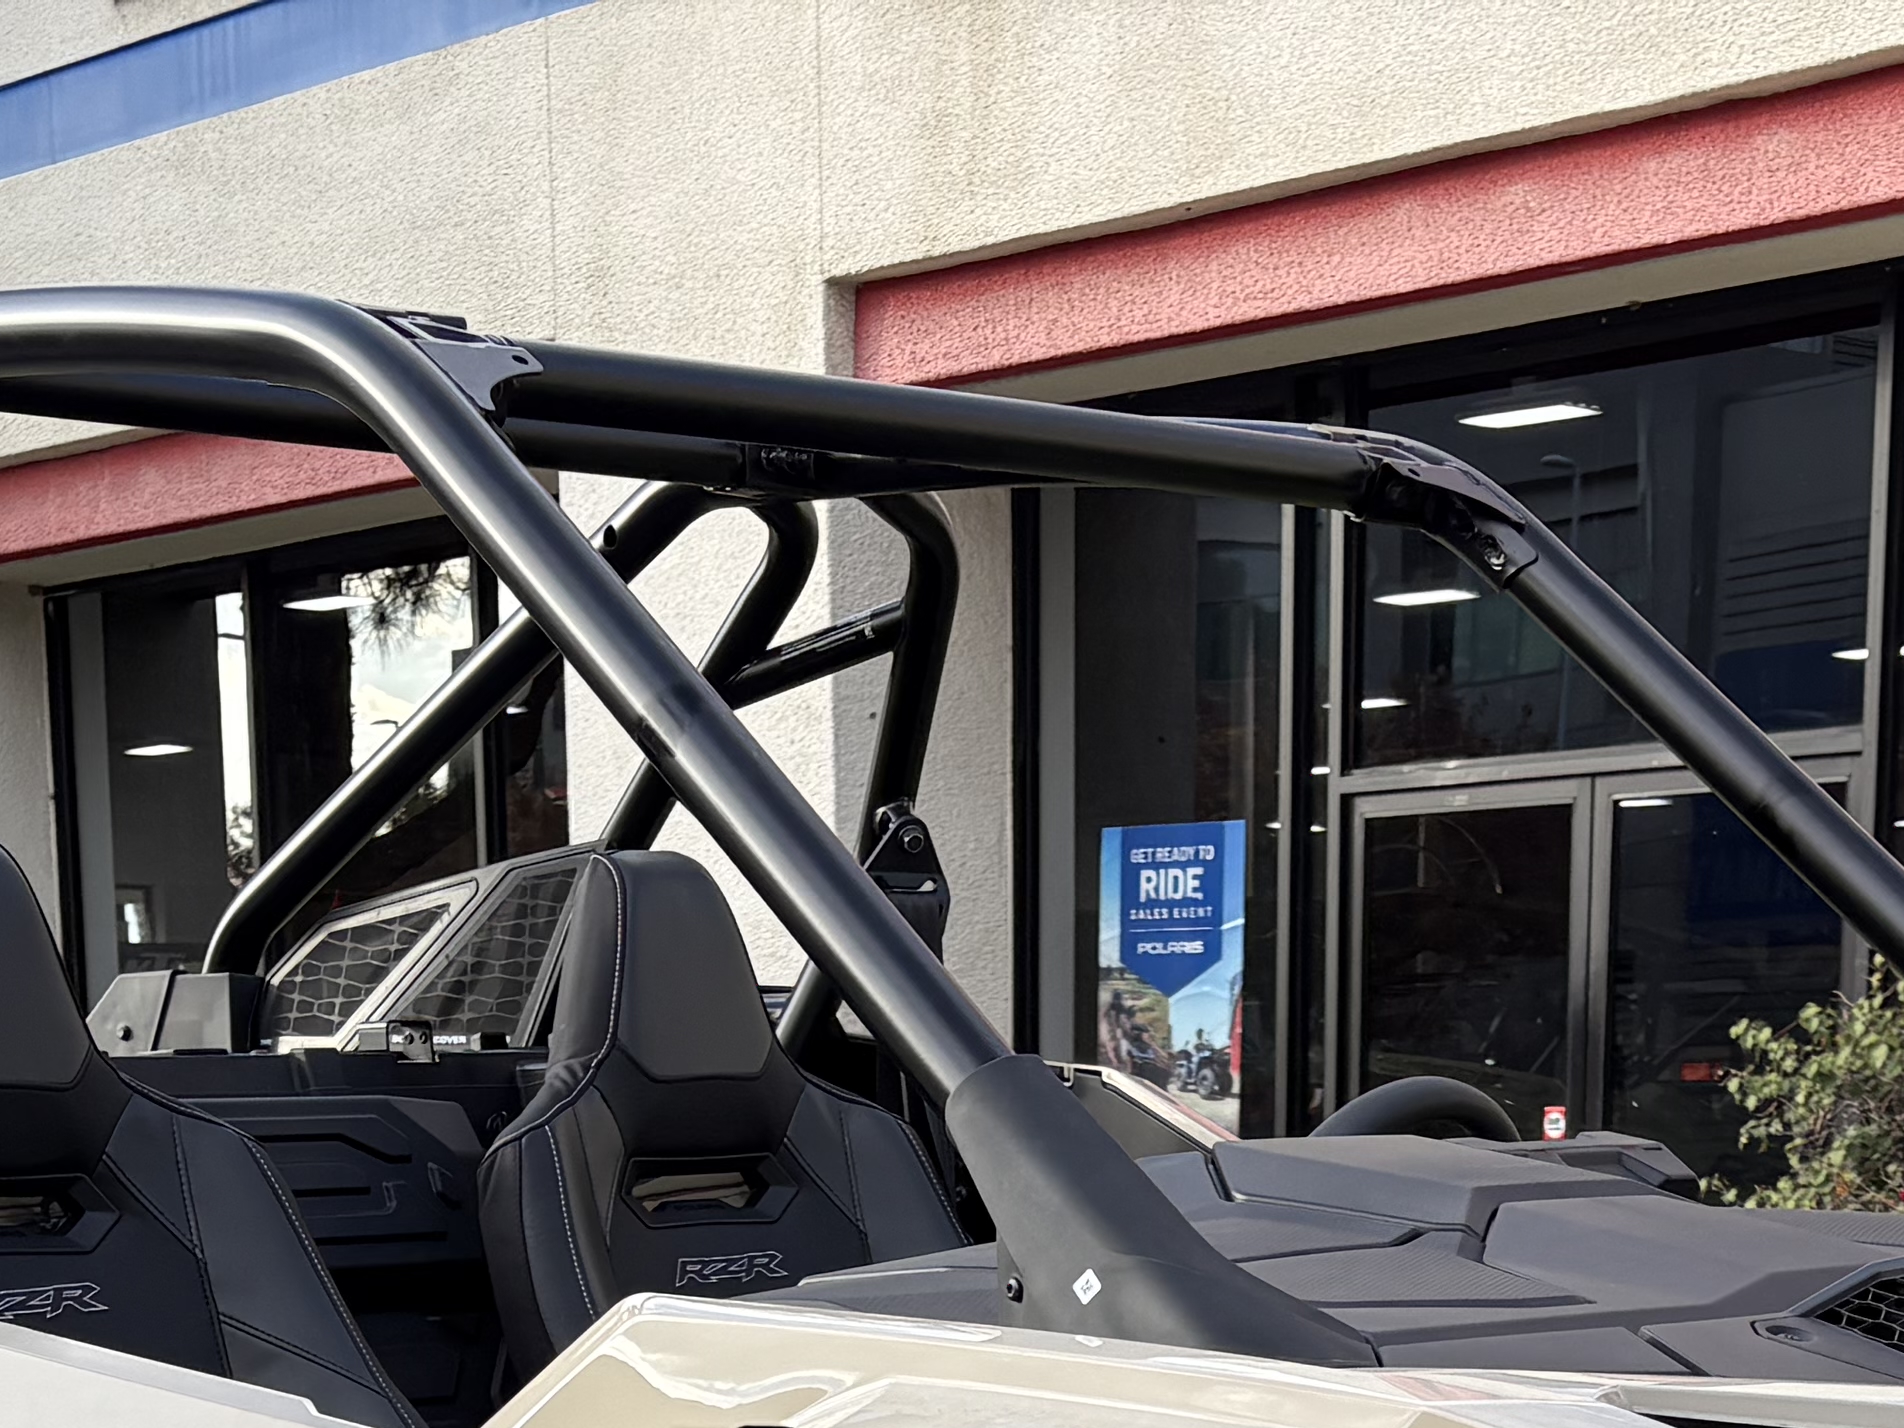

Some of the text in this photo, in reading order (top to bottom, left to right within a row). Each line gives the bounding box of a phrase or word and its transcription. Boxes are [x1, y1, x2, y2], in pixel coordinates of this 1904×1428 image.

[1130, 845, 1215, 863] GET READY TO
[1139, 867, 1204, 902] RIDE
[1129, 906, 1213, 920] SALES EVENT
[1137, 941, 1204, 954] POLARIS
[433, 1034, 467, 1044] COVER
[676, 1250, 789, 1287] RZR
